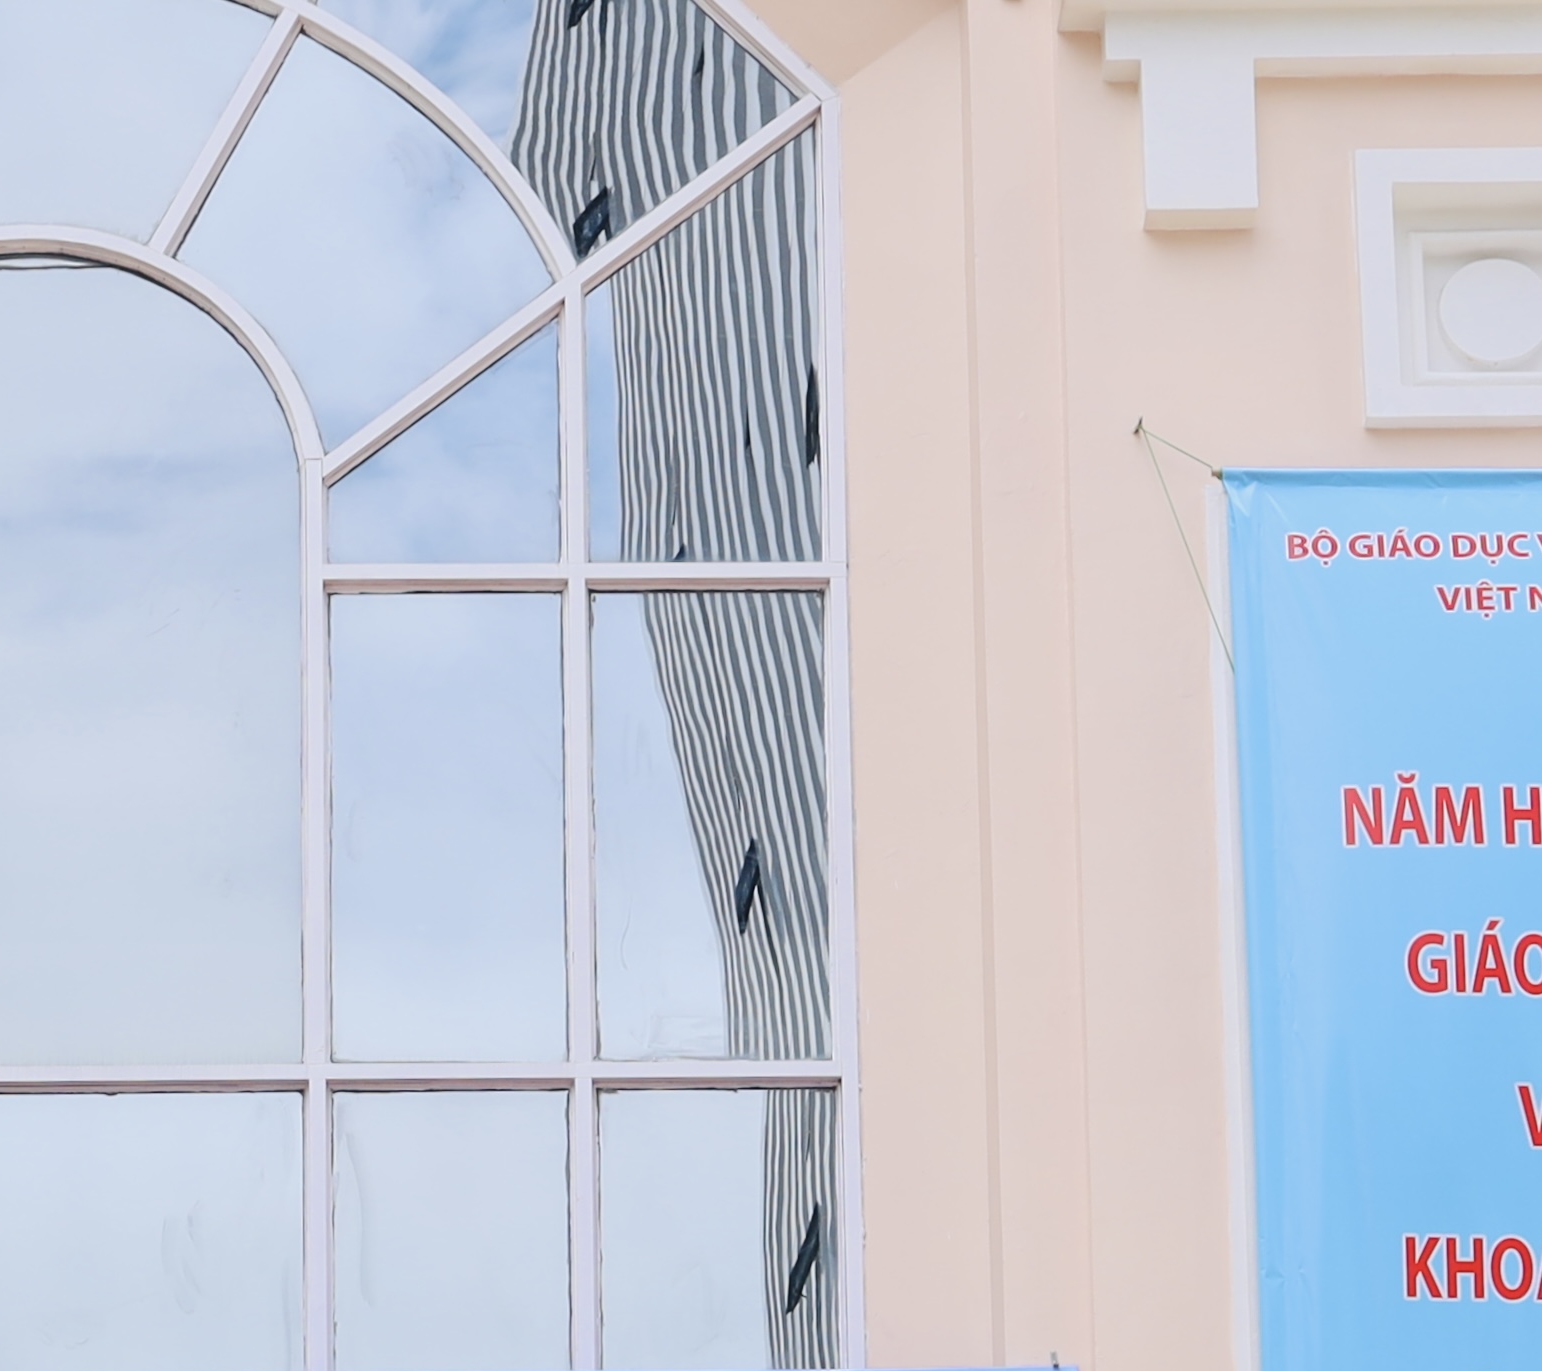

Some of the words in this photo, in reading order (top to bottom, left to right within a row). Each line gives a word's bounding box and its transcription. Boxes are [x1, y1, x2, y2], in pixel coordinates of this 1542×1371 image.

[1286, 528, 1340, 567] BỘ
[1348, 530, 1443, 560] GIÁO
[1451, 532, 1530, 565] DỤC
[1437, 580, 1519, 618] VIỆT
[1343, 772, 1487, 847] NĂM
